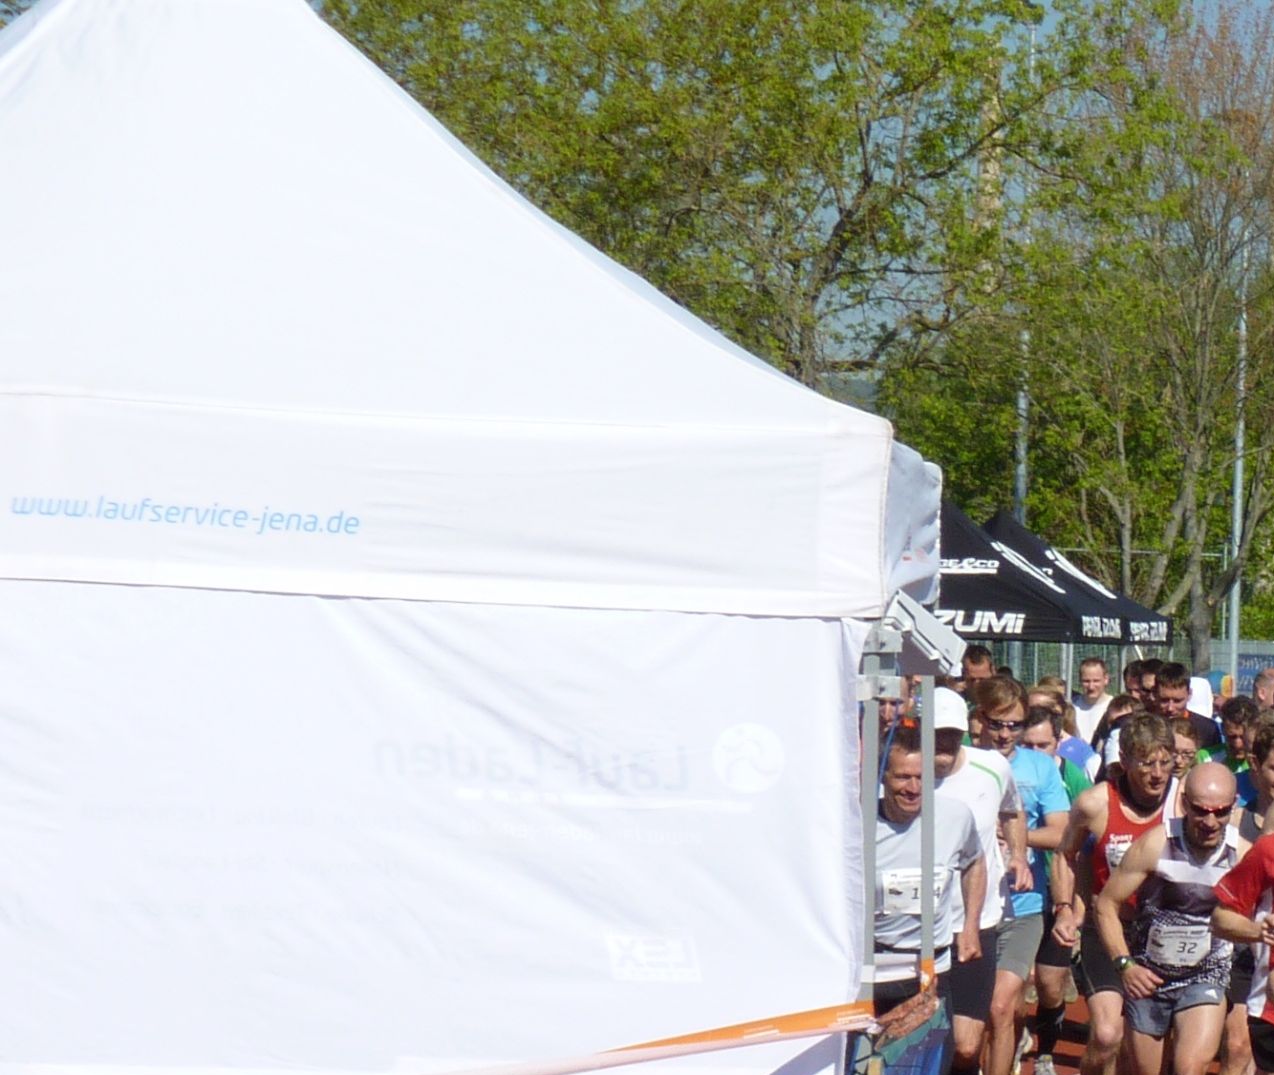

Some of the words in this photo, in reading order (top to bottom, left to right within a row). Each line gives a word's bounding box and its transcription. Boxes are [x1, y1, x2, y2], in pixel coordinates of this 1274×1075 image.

[11, 495, 361, 535] www.laufservice-jena.de
[911, 886, 942, 900] 14
[1176, 941, 1198, 954] 32
